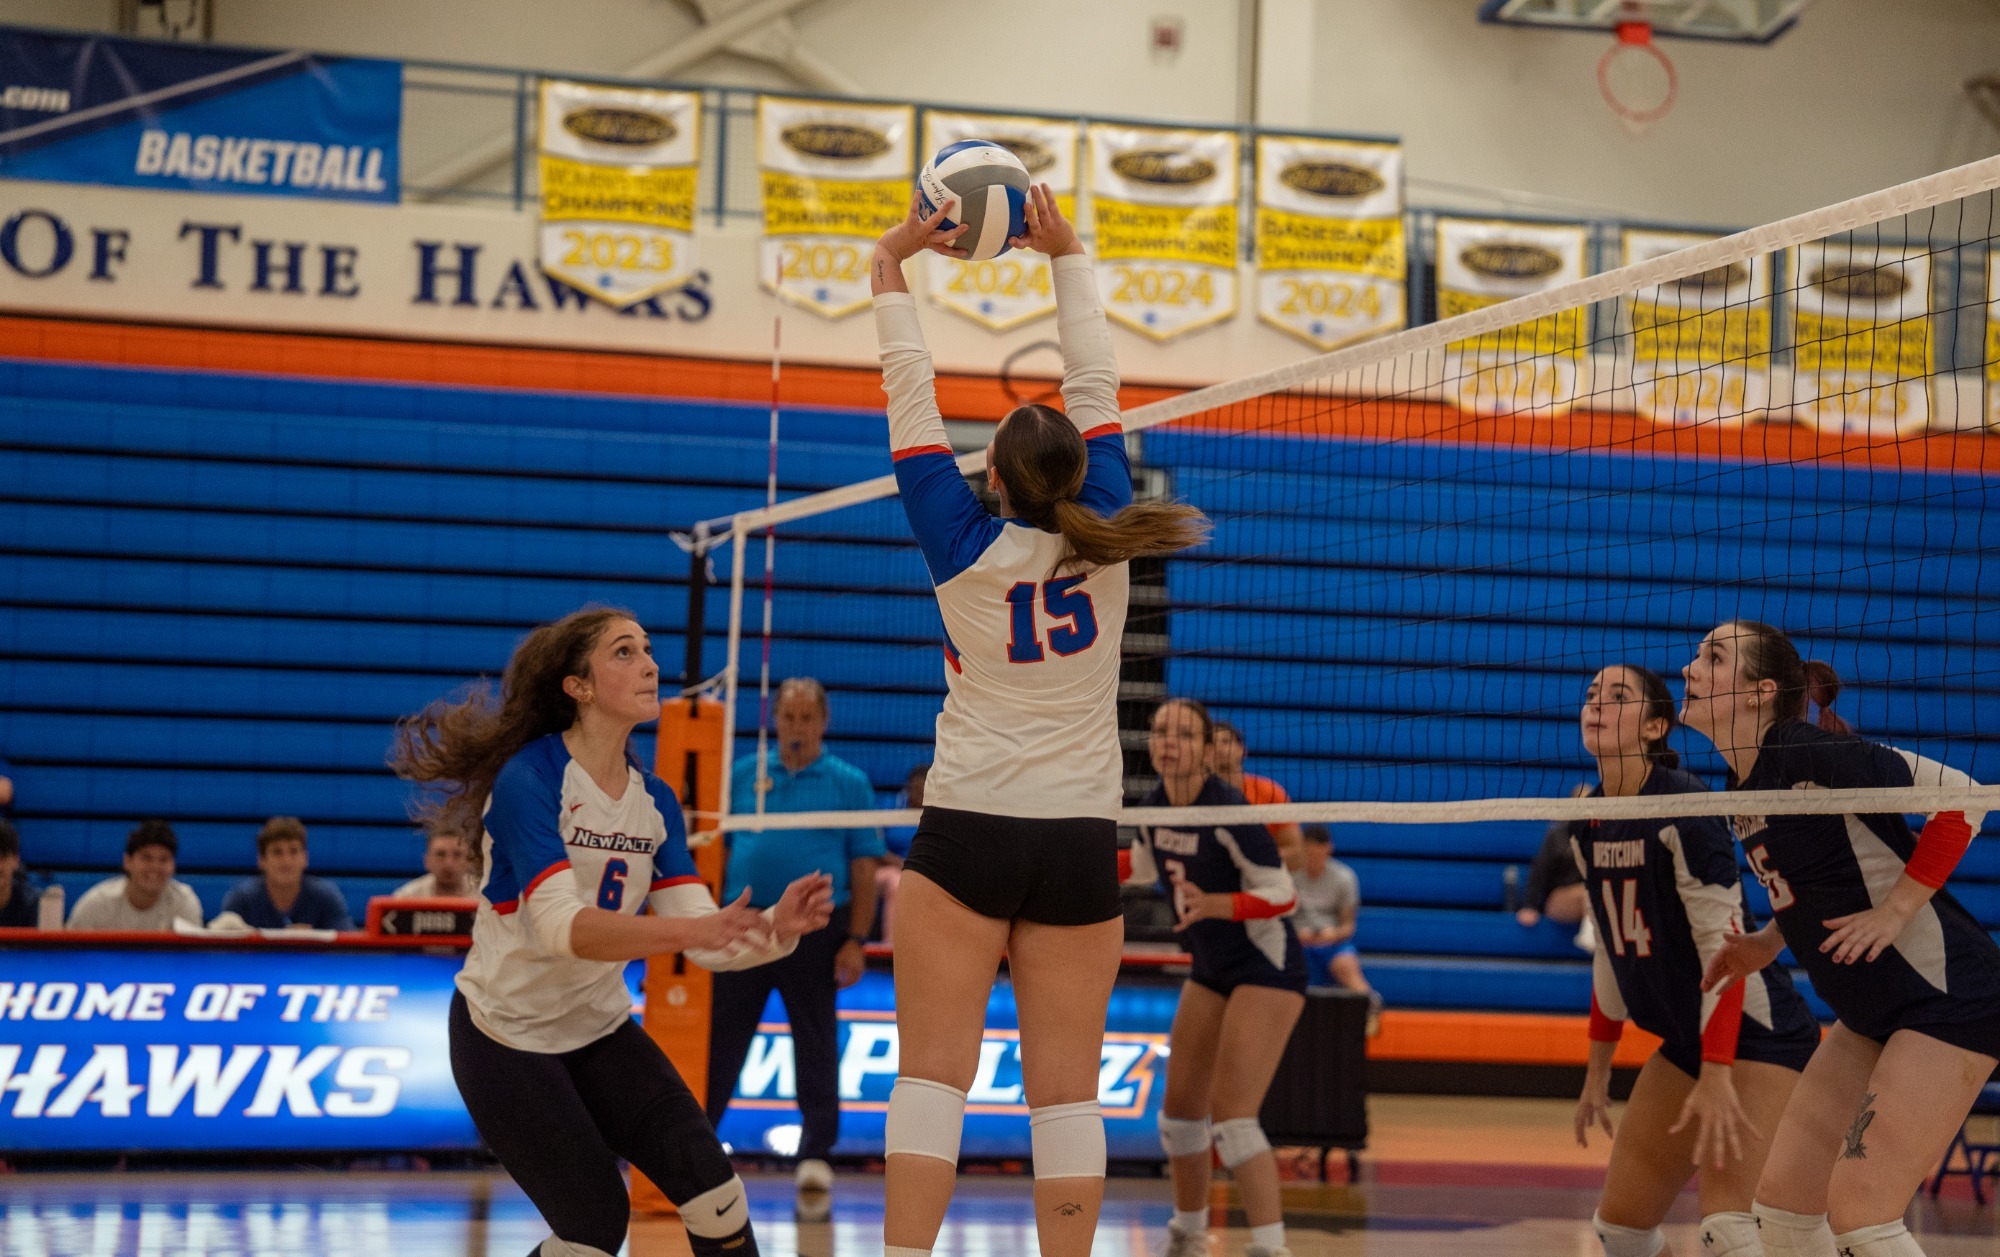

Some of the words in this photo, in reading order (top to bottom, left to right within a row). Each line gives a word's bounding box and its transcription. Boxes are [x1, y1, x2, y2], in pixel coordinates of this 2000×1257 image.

[136, 129, 386, 192] BASKETBALL
[563, 230, 674, 274] 2023
[412, 239, 713, 322] HAS
[948, 258, 1051, 298] 2024
[1112, 266, 1214, 306] 2024
[1279, 278, 1381, 320] 2024
[1461, 357, 1562, 399] 2024
[1643, 370, 1743, 411] 2024
[1005, 571, 1099, 664] 15
[596, 856, 629, 912] 6
[1602, 878, 1652, 956] 14
[0, 981, 176, 1021] HOME
[184, 983, 267, 1022] OF
[277, 984, 399, 1022] THE
[0, 1043, 413, 1118] HAWKS
[838, 1022, 1143, 1106] PLZ
